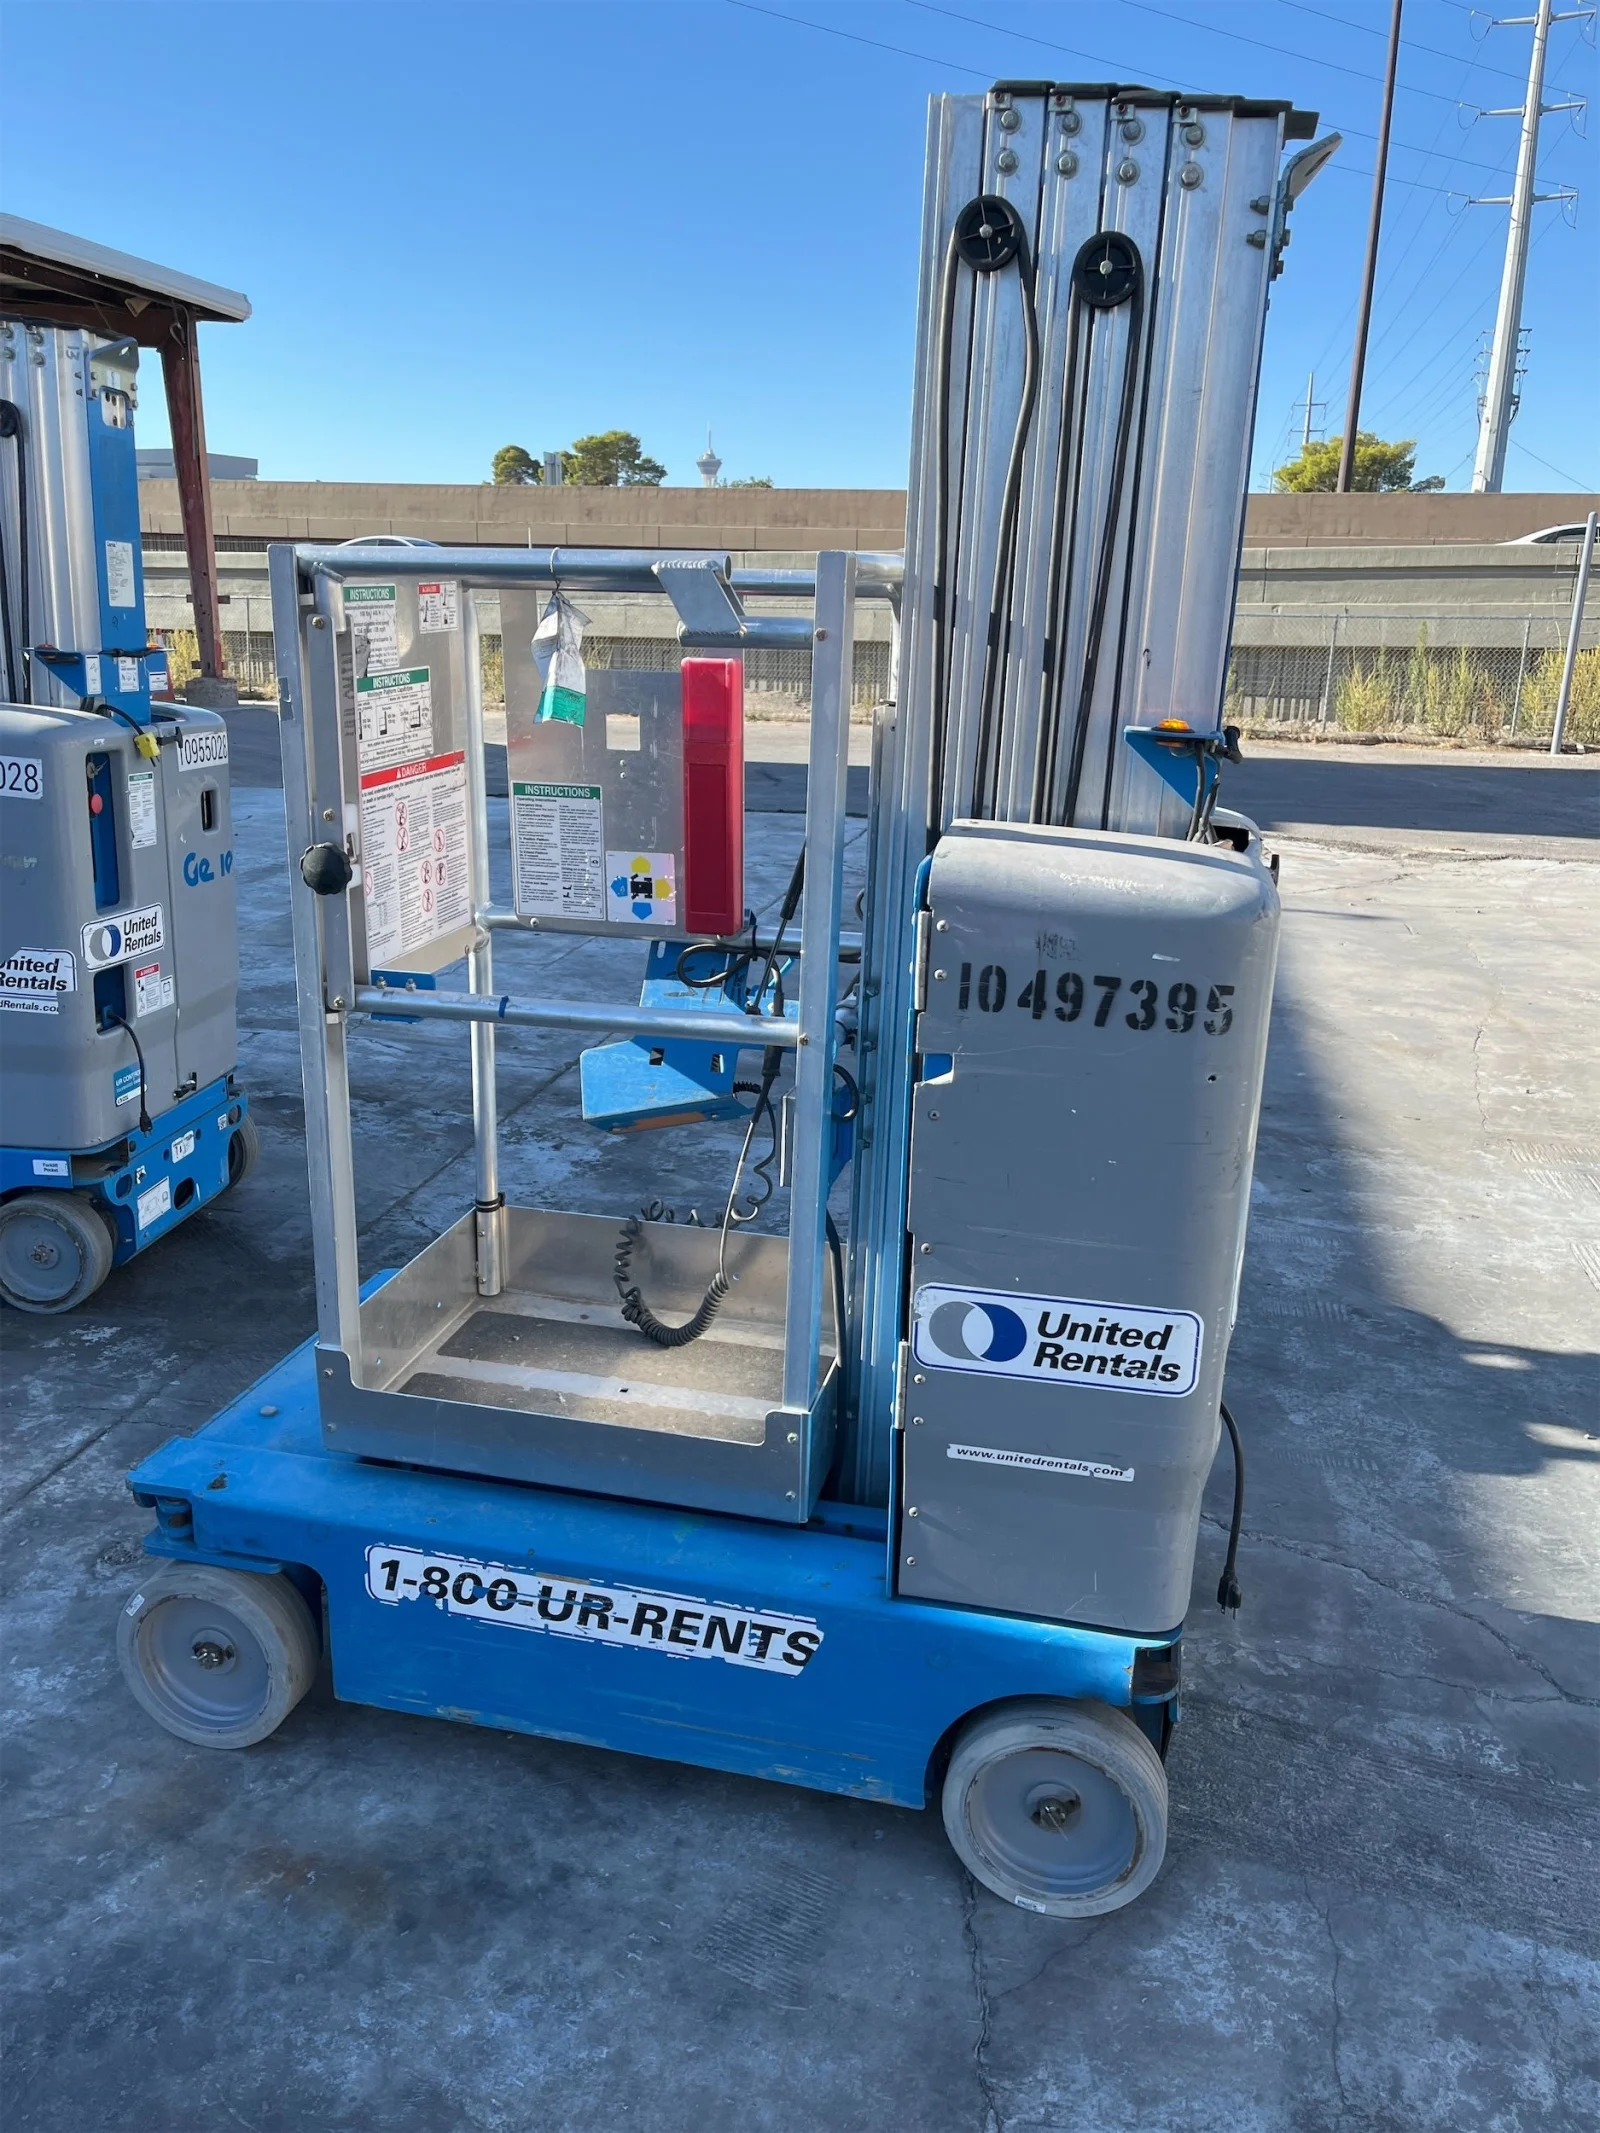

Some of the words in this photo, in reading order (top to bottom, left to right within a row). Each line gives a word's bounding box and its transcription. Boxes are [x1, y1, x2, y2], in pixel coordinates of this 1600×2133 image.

[350, 588, 390, 600] INSTRUCTIONS
[373, 673, 410, 688] INSTRUCTIONS
[401, 762, 427, 778] DANGER
[525, 785, 591, 798] INSTRUCTIONS
[123, 912, 158, 936] United
[124, 929, 162, 953] Rentals
[958, 962, 1235, 1036] 10497395
[1037, 1311, 1174, 1351] United
[1033, 1341, 1182, 1383] Rentals
[379, 1559, 821, 1668] 1-800-UR-RENTS
